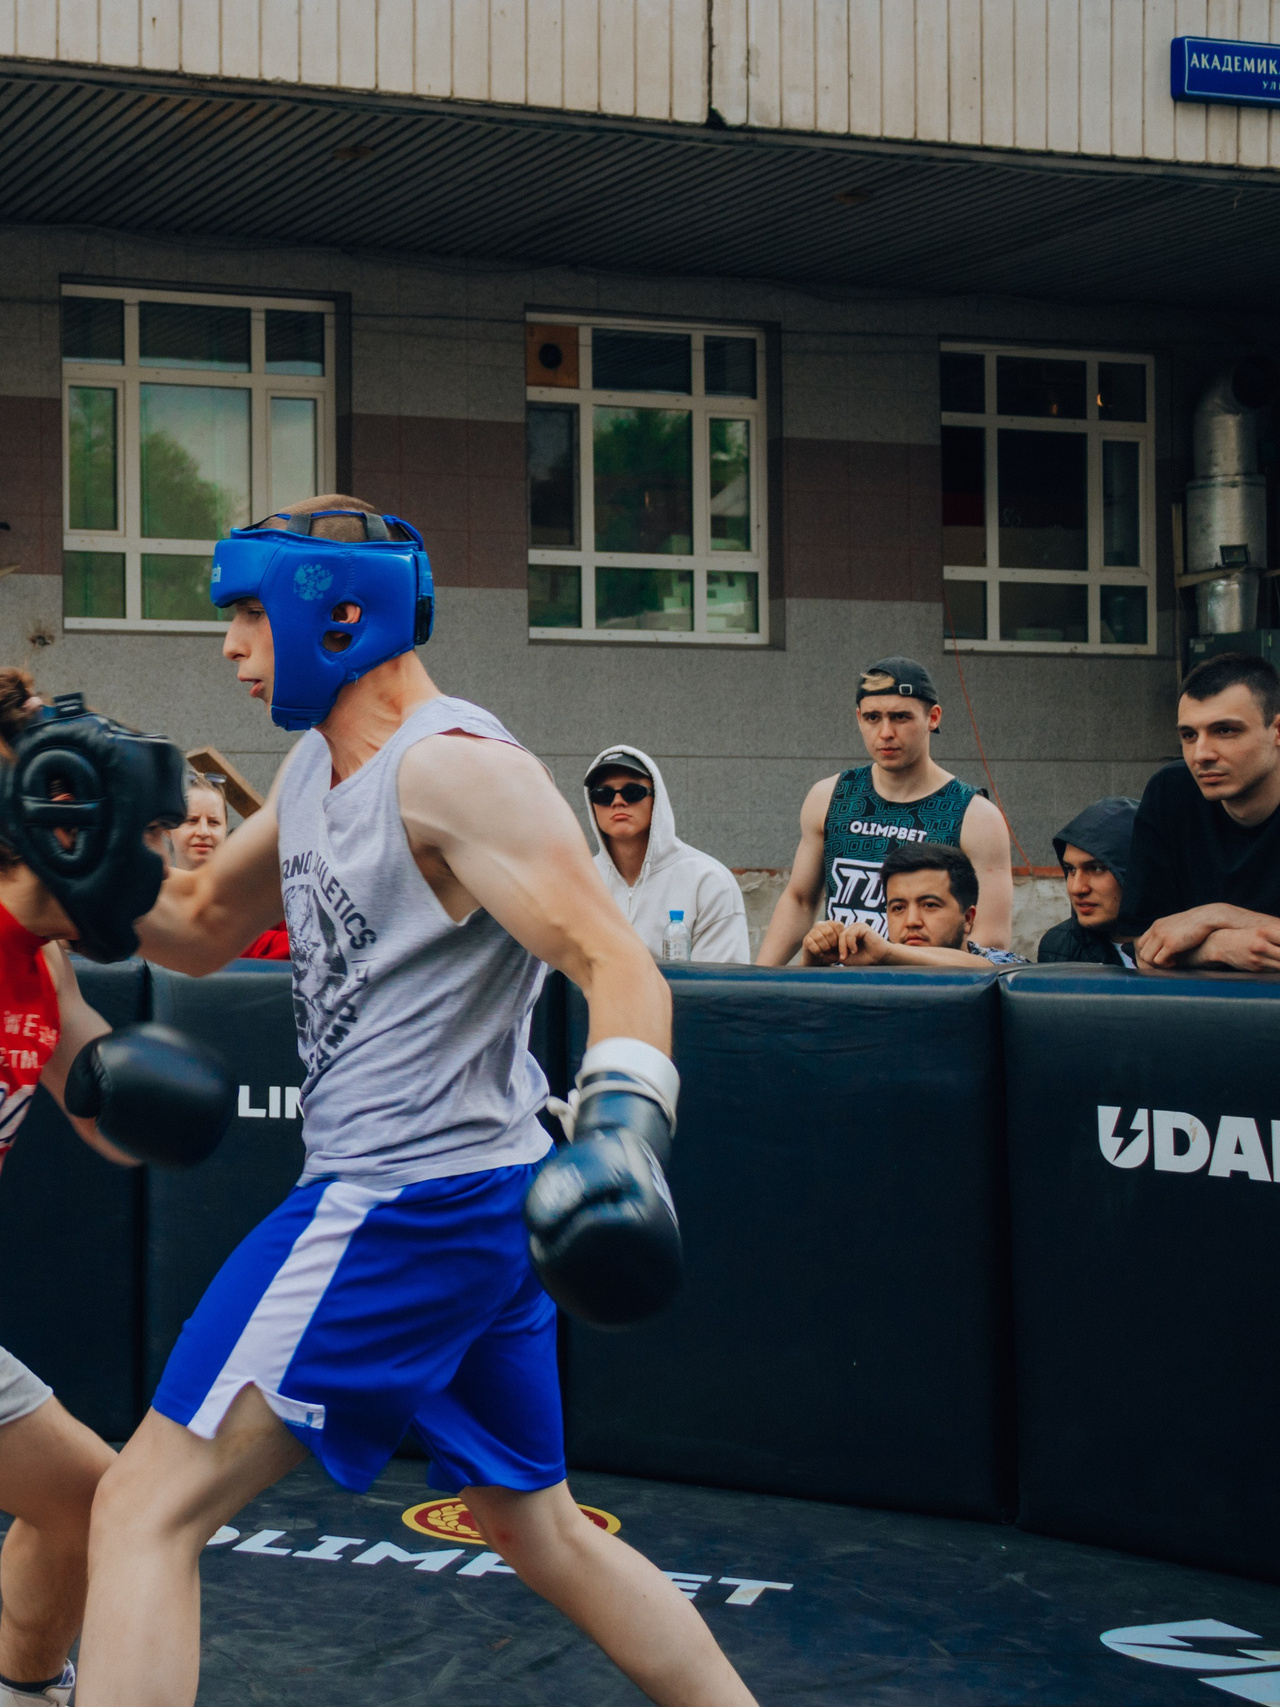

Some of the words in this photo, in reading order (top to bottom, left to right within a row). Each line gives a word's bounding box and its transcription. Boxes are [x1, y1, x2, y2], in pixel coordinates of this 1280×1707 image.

[1190, 52, 1280, 75] АКАДЕМИК
[850, 820, 927, 843] OLIMPBET
[838, 867, 887, 908] TO
